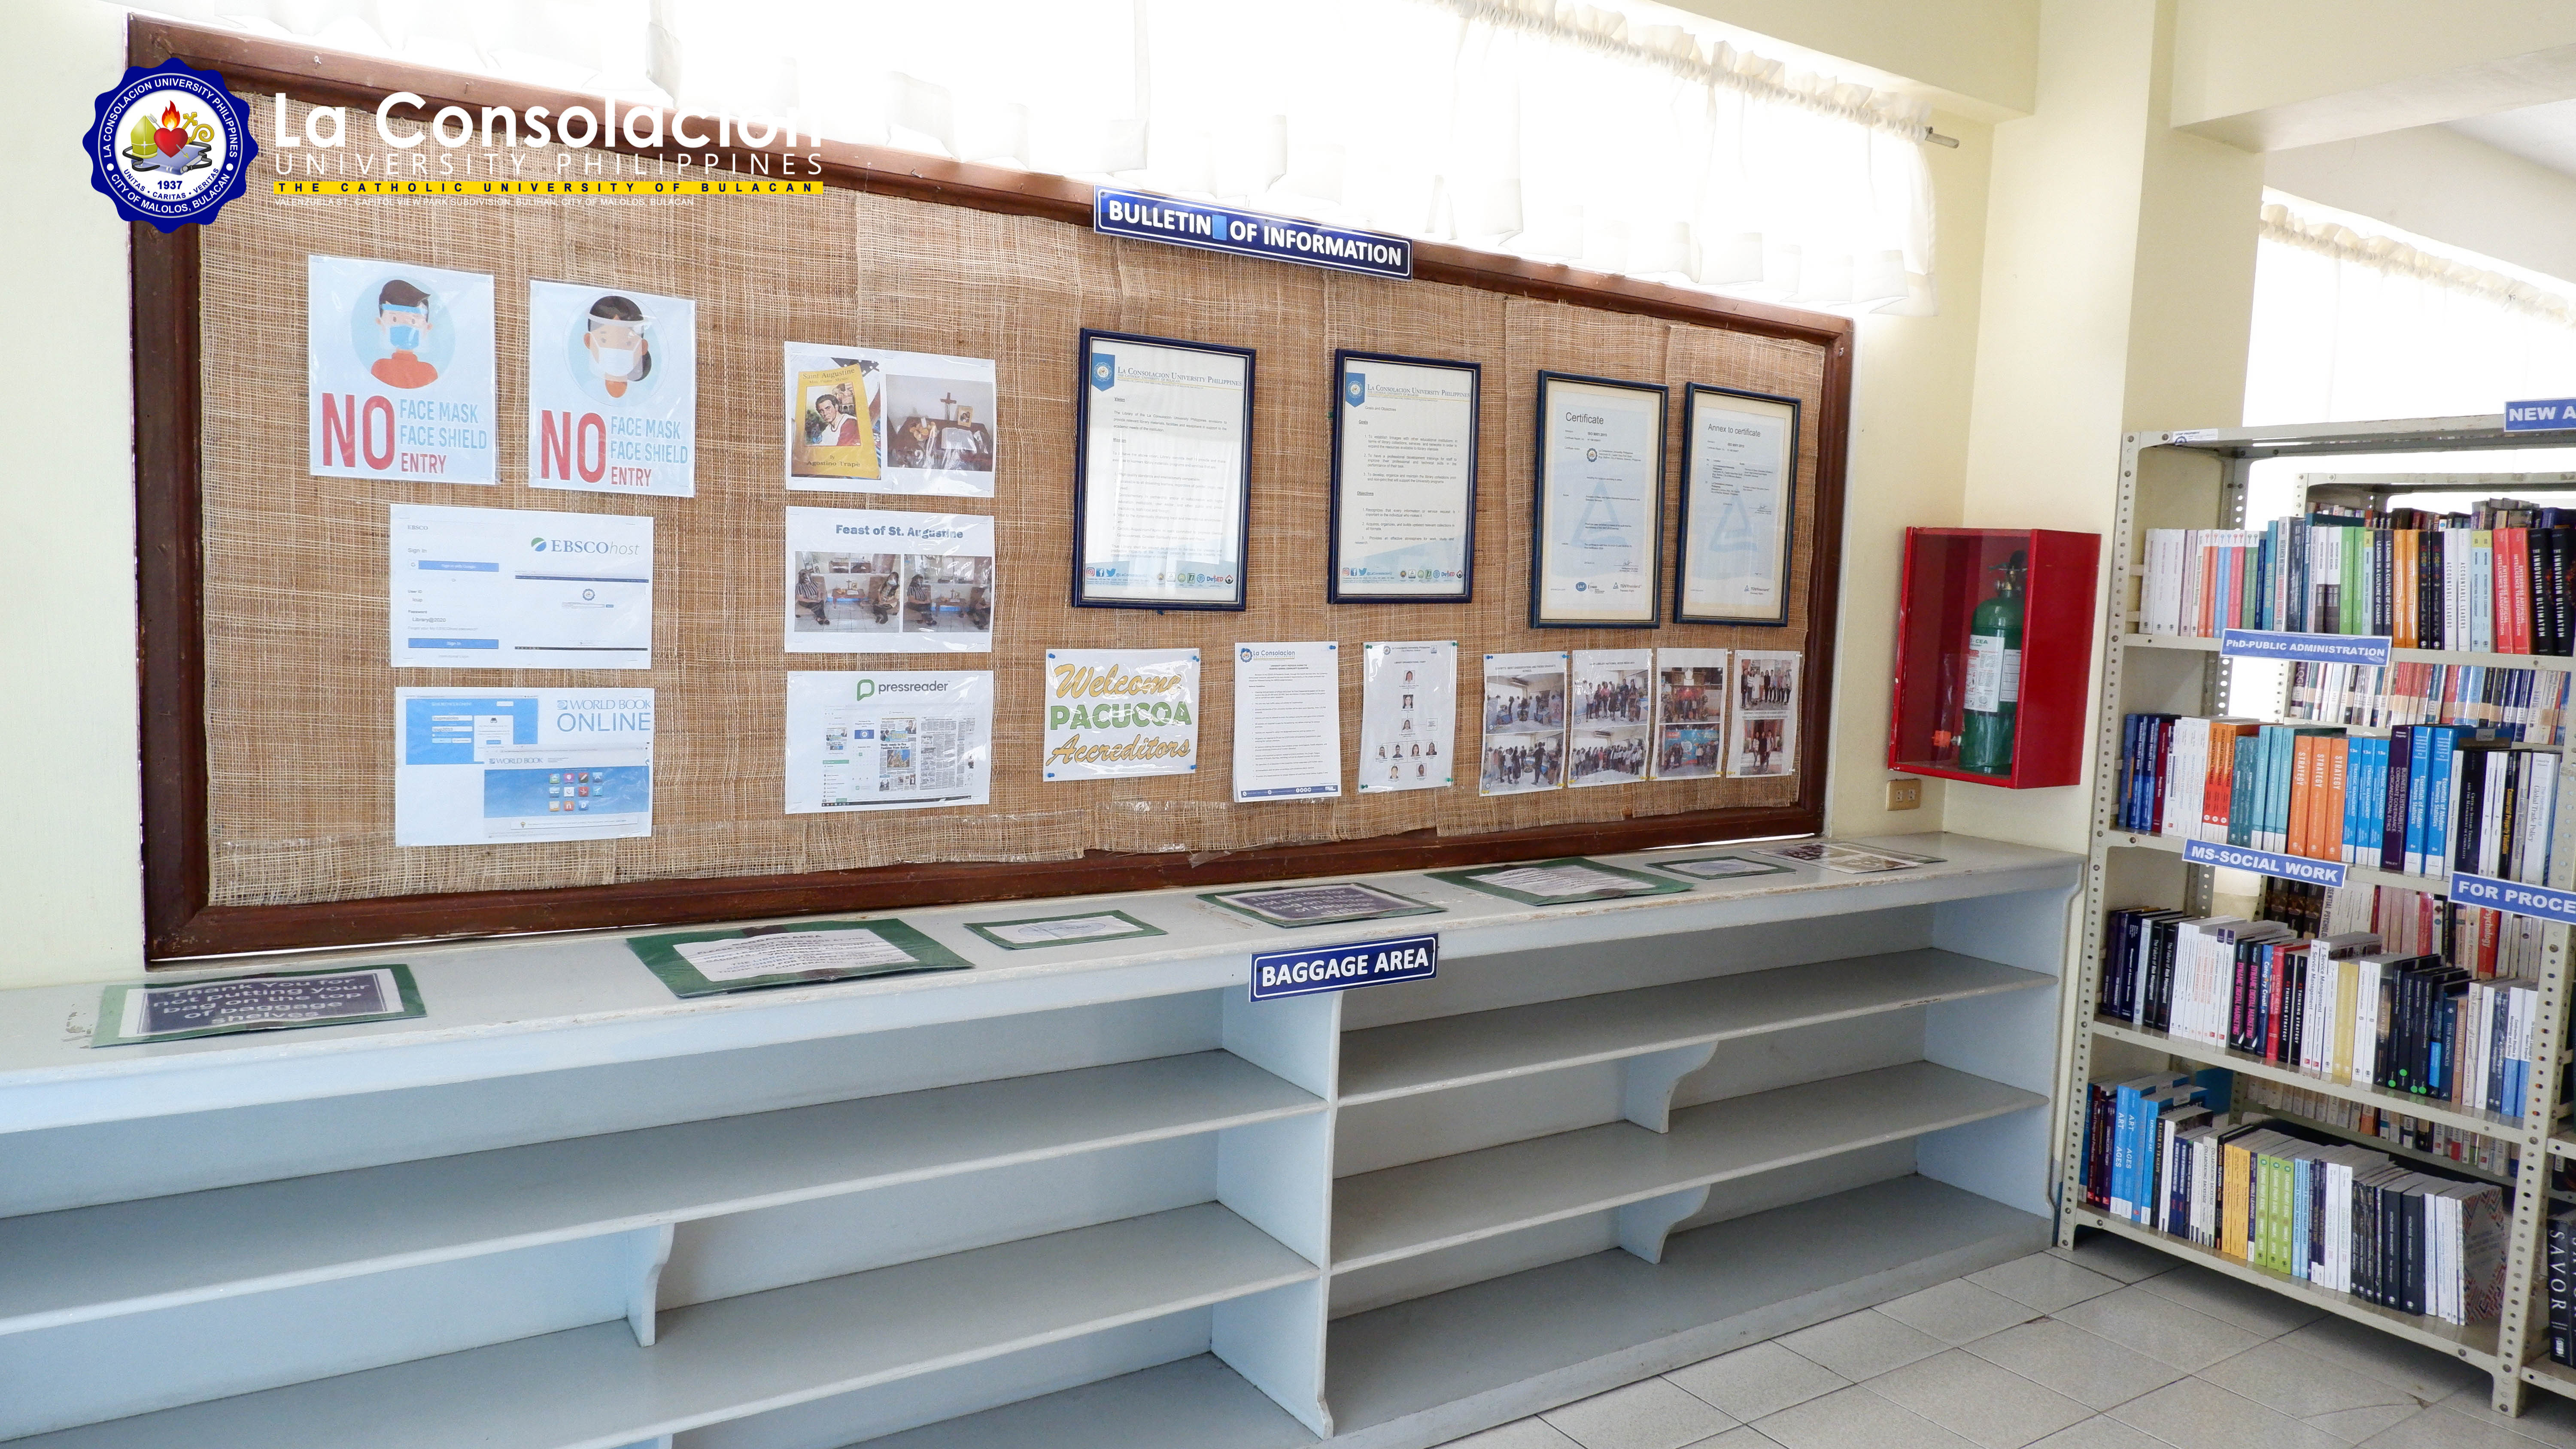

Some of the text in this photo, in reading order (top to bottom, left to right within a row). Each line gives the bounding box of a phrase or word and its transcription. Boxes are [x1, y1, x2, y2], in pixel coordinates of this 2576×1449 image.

[1109, 200, 1401, 266] BULLETIN OF INFORMATION
[802, 367, 855, 380] Saint Augustine
[400, 399, 478, 423] FACE MASK
[1566, 412, 1604, 424] Certificate
[2509, 407, 2556, 421] NEW
[322, 393, 395, 470] NO
[400, 425, 487, 449] FACE SHIELD
[611, 416, 680, 440] FACE MASK
[1708, 423, 1726, 433] Annex
[1735, 427, 1761, 437] certificate
[541, 409, 606, 483] NO
[610, 441, 688, 464] FACE SHIELD
[401, 452, 447, 474] ENTRY
[611, 466, 651, 487] ENTRY
[836, 524, 963, 539] Feast of St. Augustine
[551, 540, 640, 555] EBSCOhost
[2533, 555, 2545, 637] INNOVATION ULTIMATUM
[2554, 555, 2564, 637] INNOVATION ULTIMATUM
[2226, 640, 2385, 658] PhD-PUBLIC ADMINISTRATION
[879, 680, 948, 695] pressreader
[1054, 664, 1182, 698] Welcome
[570, 700, 615, 709] WORLD
[619, 699, 651, 709] BOOK
[1051, 701, 1192, 730] PACUCOA
[557, 712, 650, 732] ONLINE
[1045, 734, 1191, 767] Accreditors
[2296, 752, 2306, 786] STRATEGY
[2315, 754, 2325, 788] STRATEGY
[2333, 755, 2343, 790] STRATEGY
[2527, 785, 2540, 842] Global Trade Policy
[2191, 846, 2339, 882] MS-SOCIAL WORK
[2458, 881, 2576, 914] FOR PROCE
[2482, 909, 2494, 948] Psychology
[1262, 948, 1428, 987] BAGGAGE AREA
[154, 984, 370, 1007] not putting your
[168, 984, 253, 997] Thank
[2245, 965, 2258, 1039] DYNAMIC DIGITAL MARKETING
[163, 1002, 216, 1013] bag
[184, 1001, 343, 1019] of baggage
[211, 1011, 319, 1024] shelves
[2549, 1229, 2567, 1310] SAVOR
